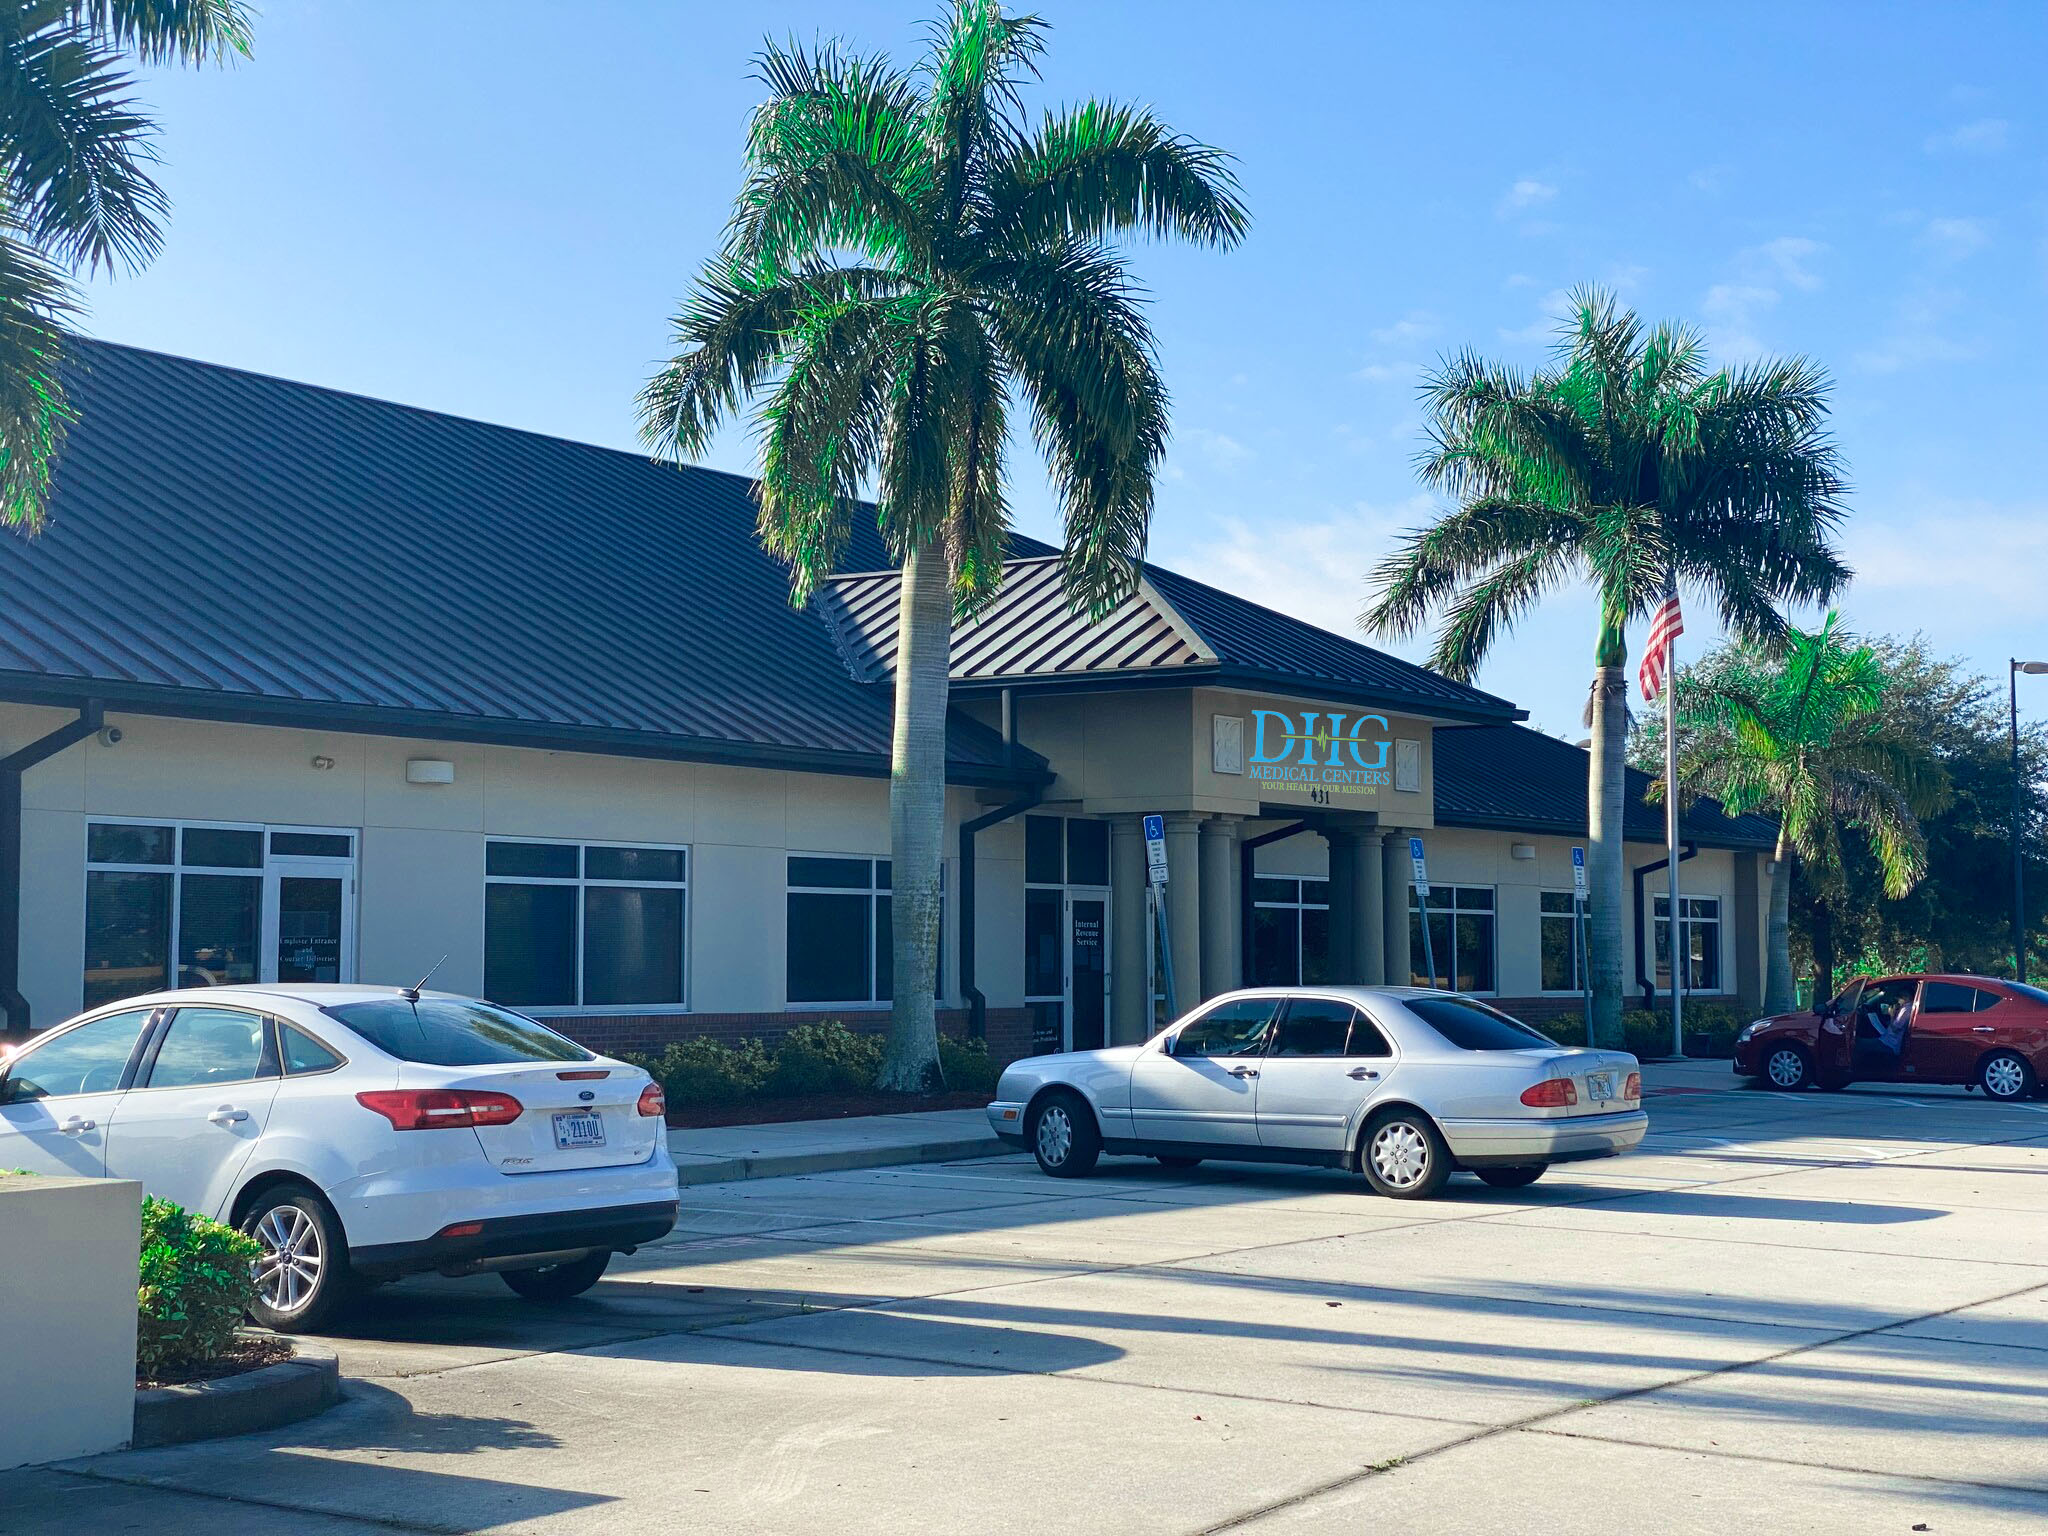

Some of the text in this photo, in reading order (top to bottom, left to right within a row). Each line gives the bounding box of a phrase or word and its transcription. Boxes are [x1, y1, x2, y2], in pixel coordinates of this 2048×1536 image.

[1248, 709, 1392, 770] DHG
[1248, 766, 1391, 785] MEDICAL CENTERS
[1261, 781, 1377, 795] YOUR HEALTH OUR MISSION
[1311, 787, 1330, 804] 431
[1075, 919, 1099, 928] Internal
[1075, 928, 1099, 937] Revenue
[310, 937, 337, 945] Entrance
[1076, 937, 1098, 946] Service
[571, 1120, 599, 1138] 2110U
